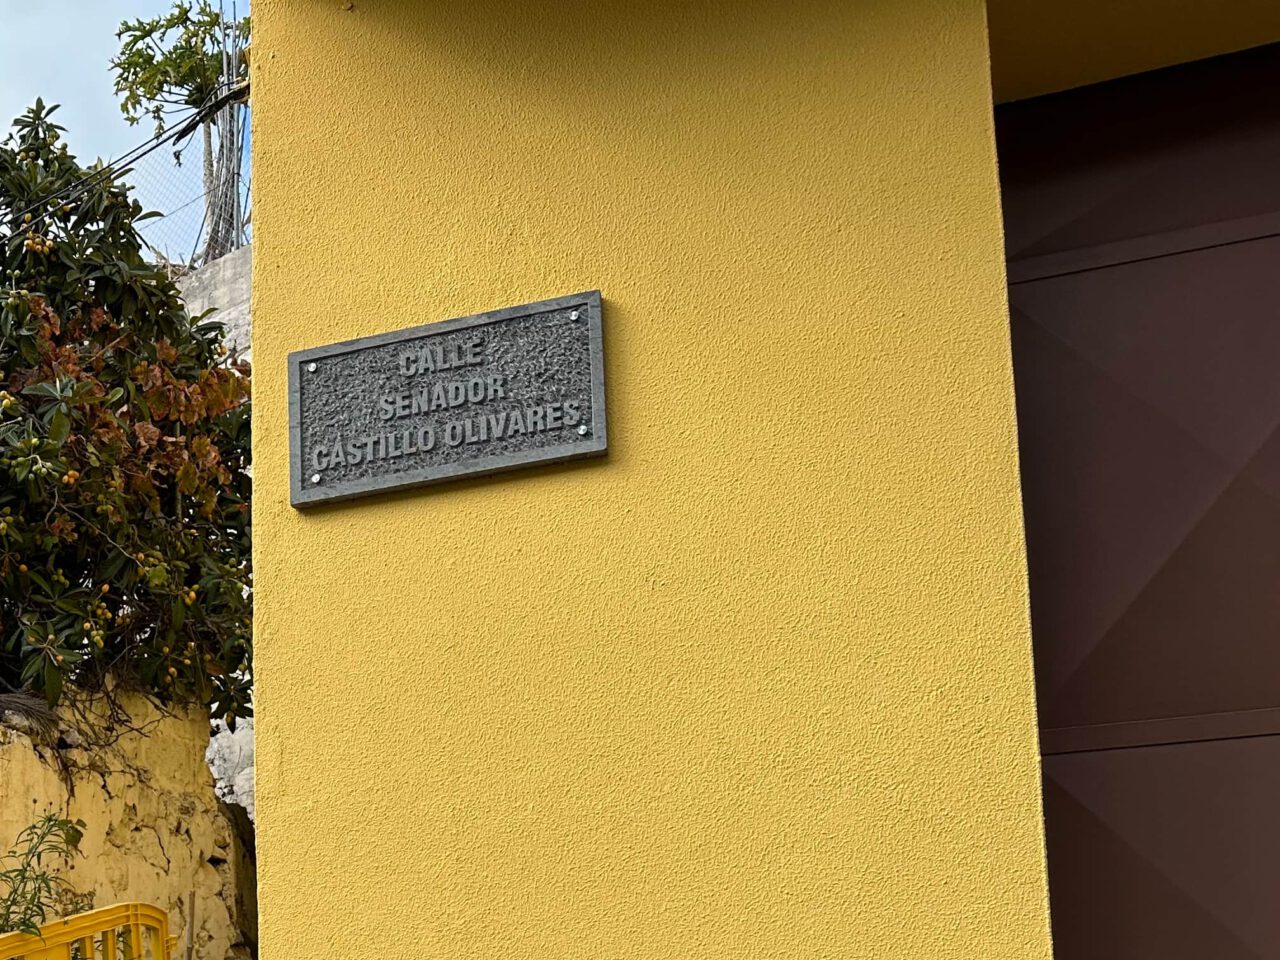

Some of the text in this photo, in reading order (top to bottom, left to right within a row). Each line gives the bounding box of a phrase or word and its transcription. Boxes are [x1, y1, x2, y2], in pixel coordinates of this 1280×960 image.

[400, 340, 484, 376] CALLE
[380, 375, 506, 420] SENADOR
[312, 401, 581, 471] CASTILLO OLIVARES
